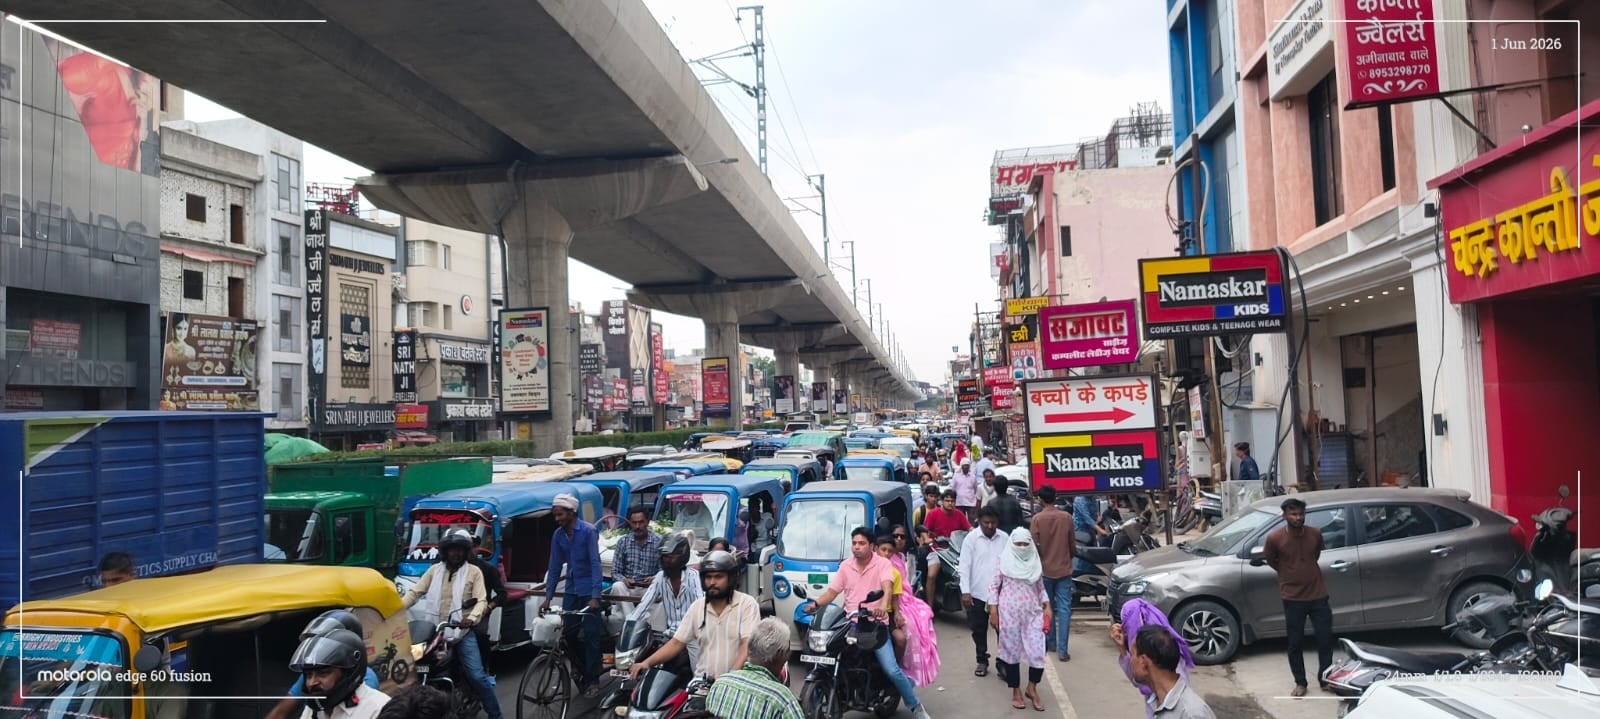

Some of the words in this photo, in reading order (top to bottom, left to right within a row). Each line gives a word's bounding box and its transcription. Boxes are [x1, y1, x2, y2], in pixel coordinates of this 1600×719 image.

[1355, 11, 1426, 45] ज्वैलर्स
[1356, 50, 1406, 65] अमीनाबाद
[1410, 46, 1429, 61] वाले
[1369, 64, 1431, 79] 8953298770
[309, 210, 322, 231] श्री
[1449, 217, 1499, 280] चन्द्र
[1494, 166, 1581, 263] कान्ती
[305, 234, 326, 249] नाथ
[308, 250, 323, 272] जी
[1159, 276, 1267, 303] Namaskar
[1233, 303, 1270, 316] KIDS
[1011, 325, 1029, 342] स्त्री
[1050, 312, 1127, 338] सजावट
[1150, 325, 1190, 335] COMPLETE
[1192, 323, 1210, 333] KIDS
[1212, 323, 1219, 331] &
[1220, 321, 1256, 331] TEENAGE
[1258, 319, 1281, 329] WEAR
[397, 345, 411, 359] SRI
[32, 361, 125, 385] TRENDS
[393, 361, 415, 375] NATH
[400, 375, 409, 390] JI
[1030, 383, 1071, 407] बच्चों
[1077, 382, 1096, 404] के
[1102, 379, 1149, 406] कपड़े
[325, 410, 338, 425] SRI
[338, 410, 357, 425] NATH
[363, 410, 397, 427] JEWELLERS
[1046, 451, 1143, 474] Namaskar
[1109, 476, 1144, 488] KIDS
[163, 554, 198, 573] SUPPLY
